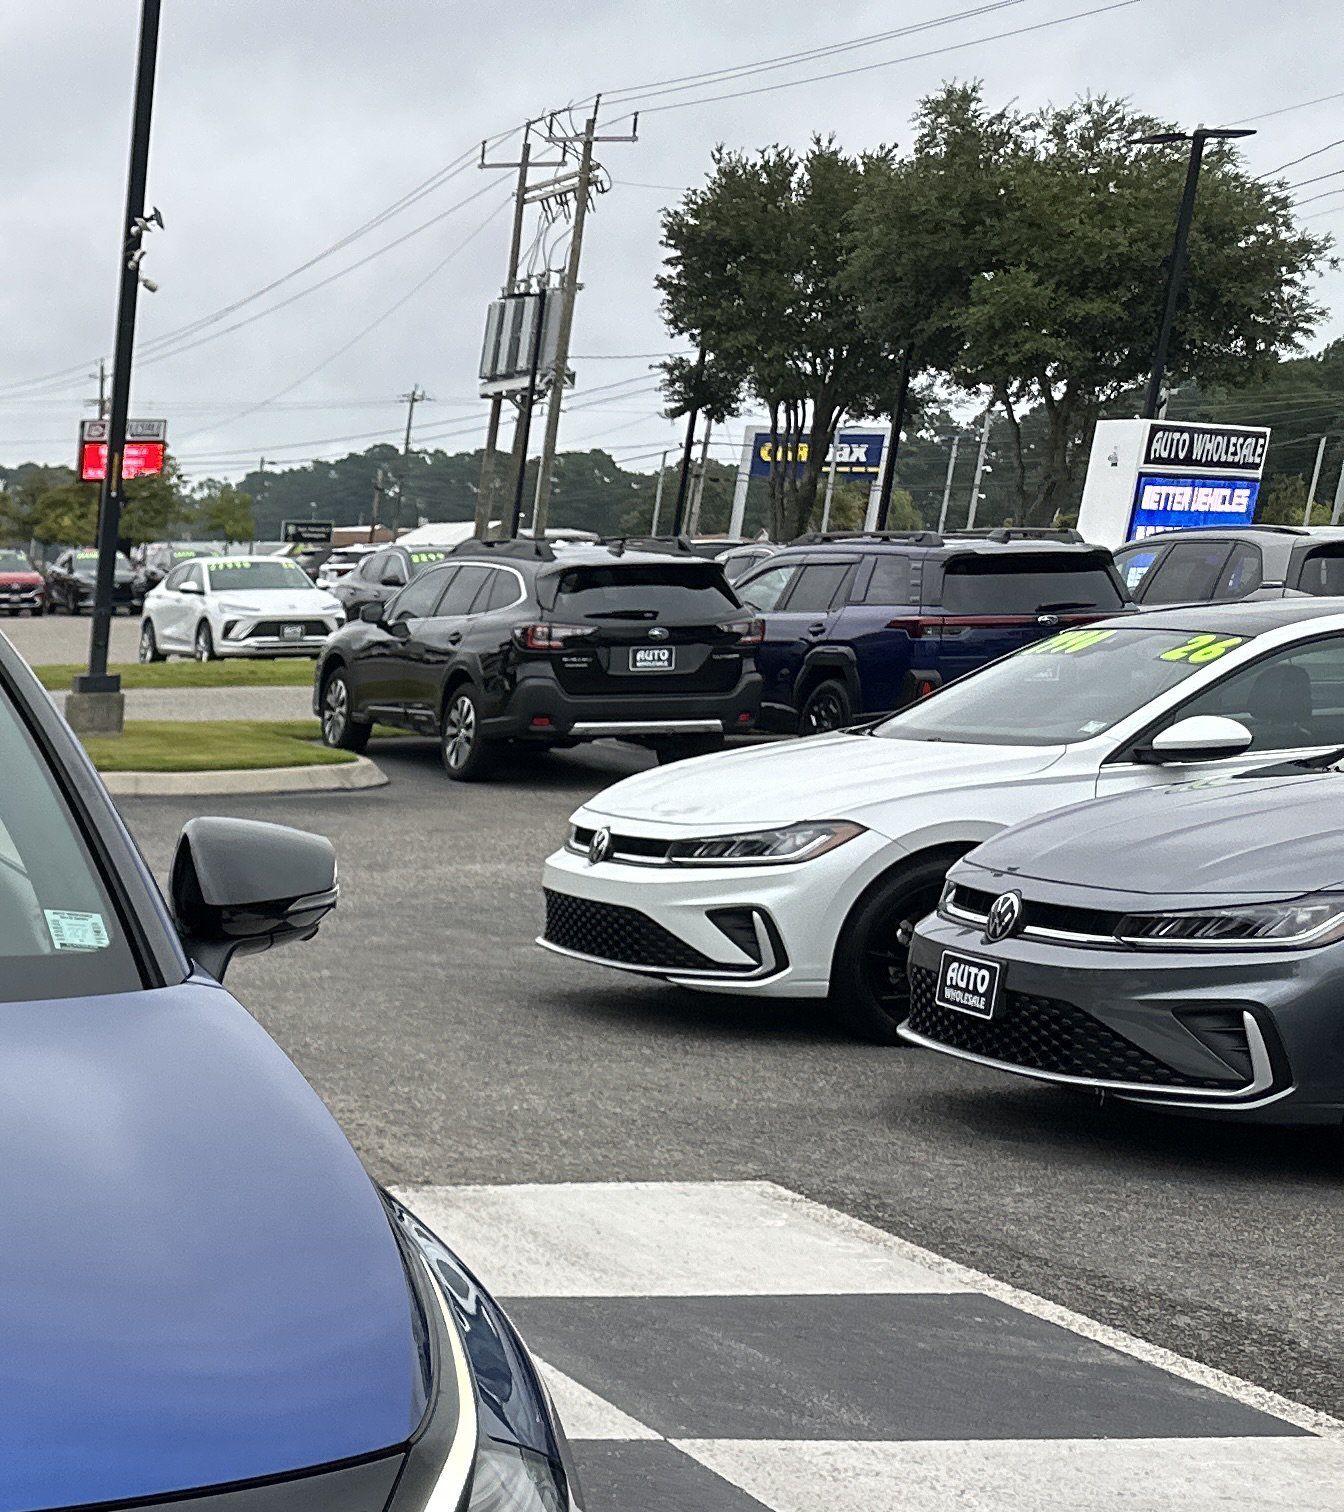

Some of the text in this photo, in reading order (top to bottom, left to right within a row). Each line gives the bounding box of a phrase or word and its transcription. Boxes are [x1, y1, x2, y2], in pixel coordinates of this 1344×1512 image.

[1150, 430, 1265, 465] AUTO WHOLESALE
[636, 649, 669, 661] AUTO
[946, 961, 990, 994] AUTO
[944, 986, 986, 1010] WHOLESALE
